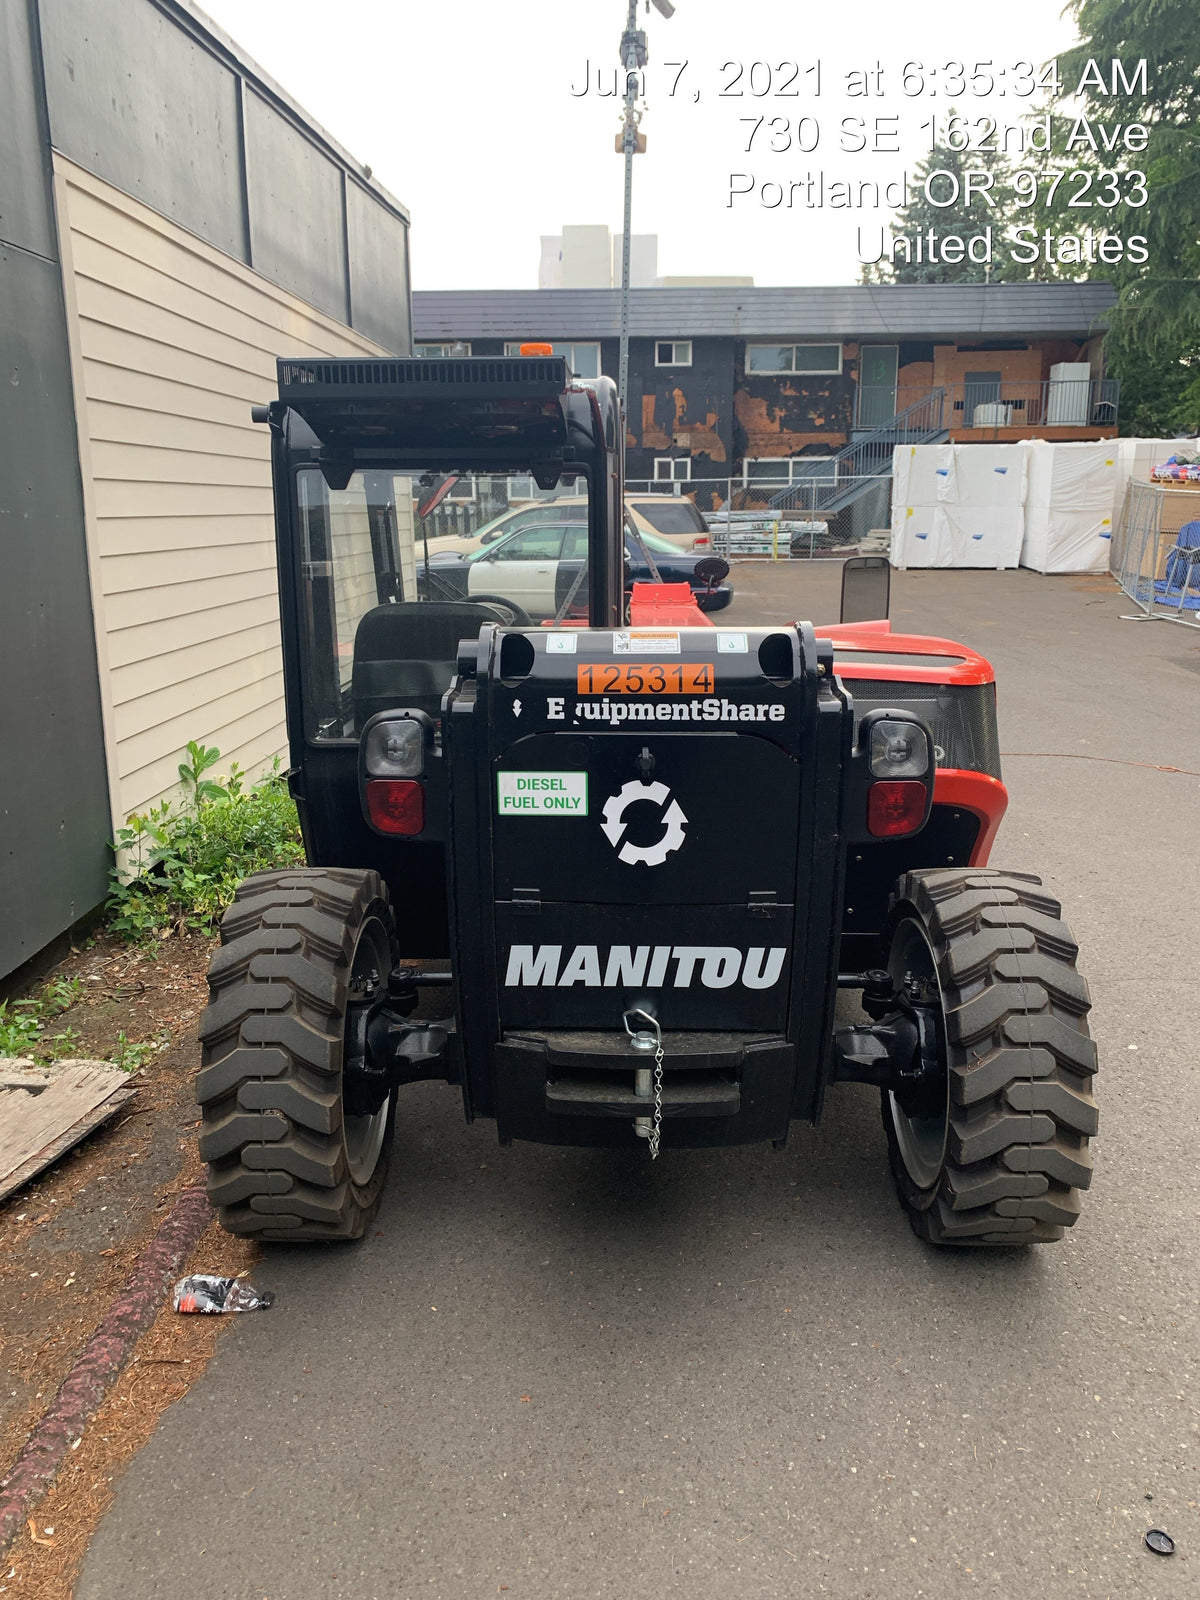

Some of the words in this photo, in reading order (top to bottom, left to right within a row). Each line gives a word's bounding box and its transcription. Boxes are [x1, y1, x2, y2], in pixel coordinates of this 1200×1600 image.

[581, 665, 712, 693] 125314
[516, 778, 568, 791] DIESEL
[503, 796, 540, 809] FUEL
[543, 796, 582, 809] ONLY
[504, 944, 788, 990] MANITOU
